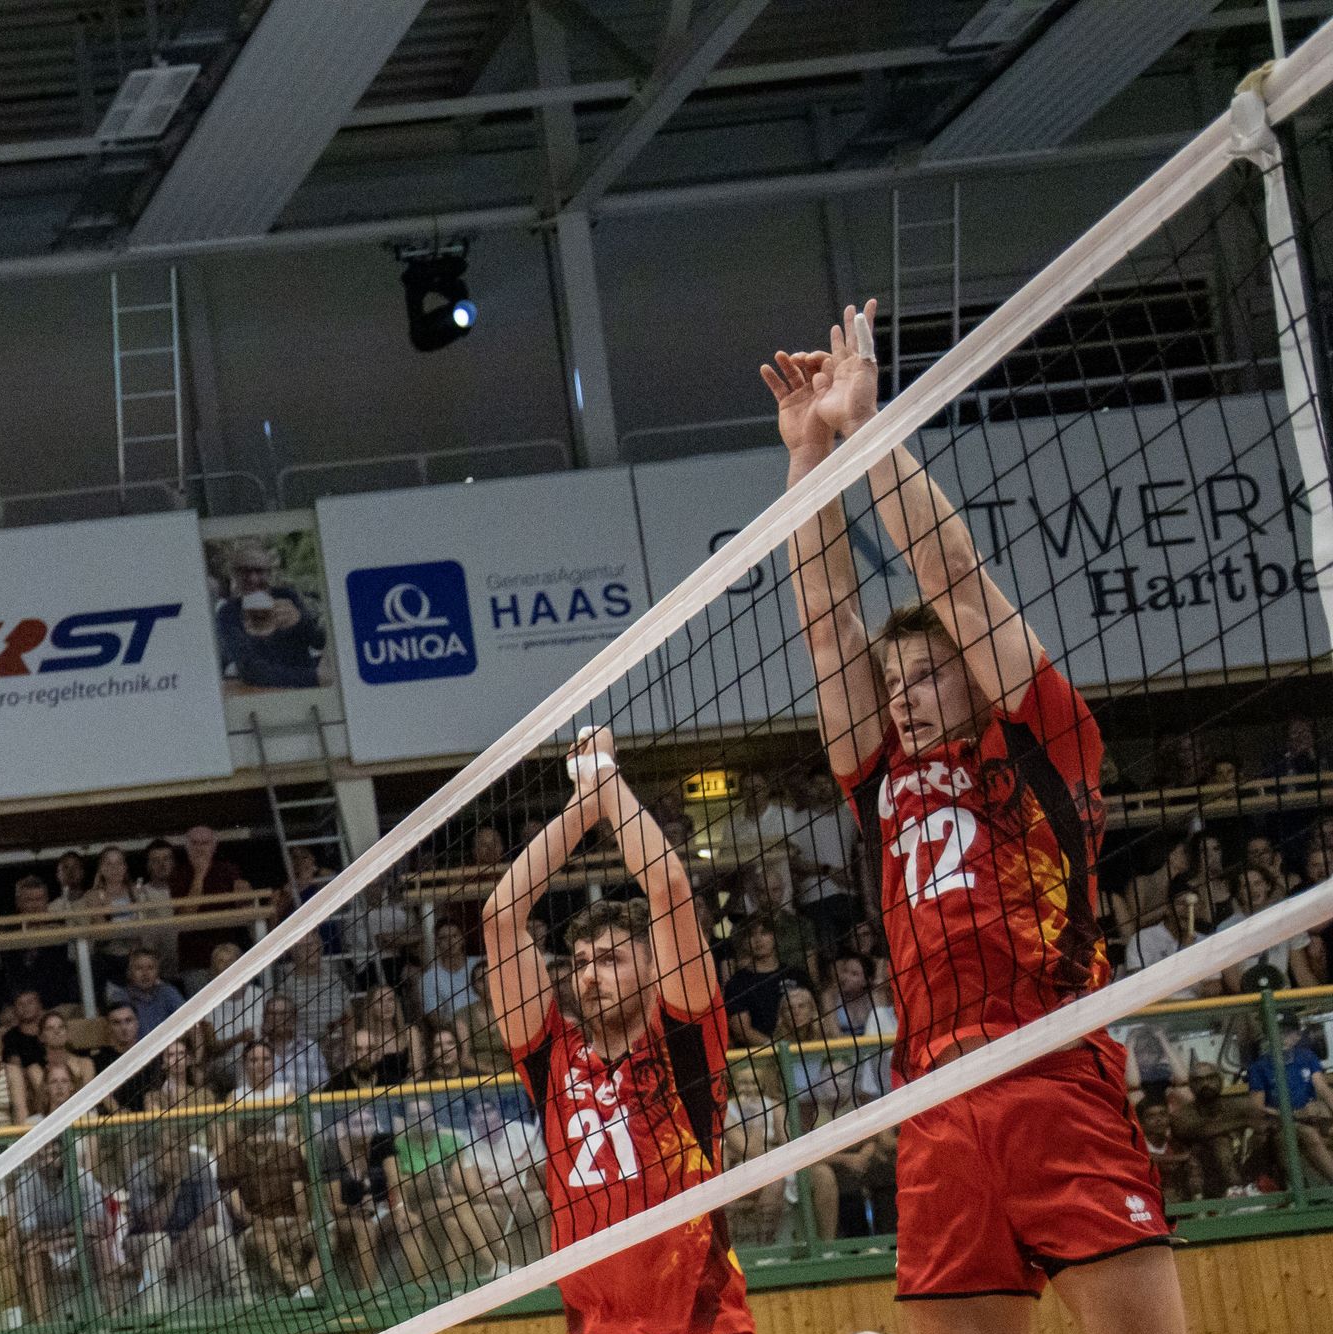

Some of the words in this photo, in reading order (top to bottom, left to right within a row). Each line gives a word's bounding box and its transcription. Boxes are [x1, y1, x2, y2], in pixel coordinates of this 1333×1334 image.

[489, 582, 632, 629] HAAS
[1085, 551, 1320, 619] Hartbe
[363, 631, 468, 666] UNIQA
[889, 805, 978, 910] 12
[567, 1107, 639, 1188] 21
